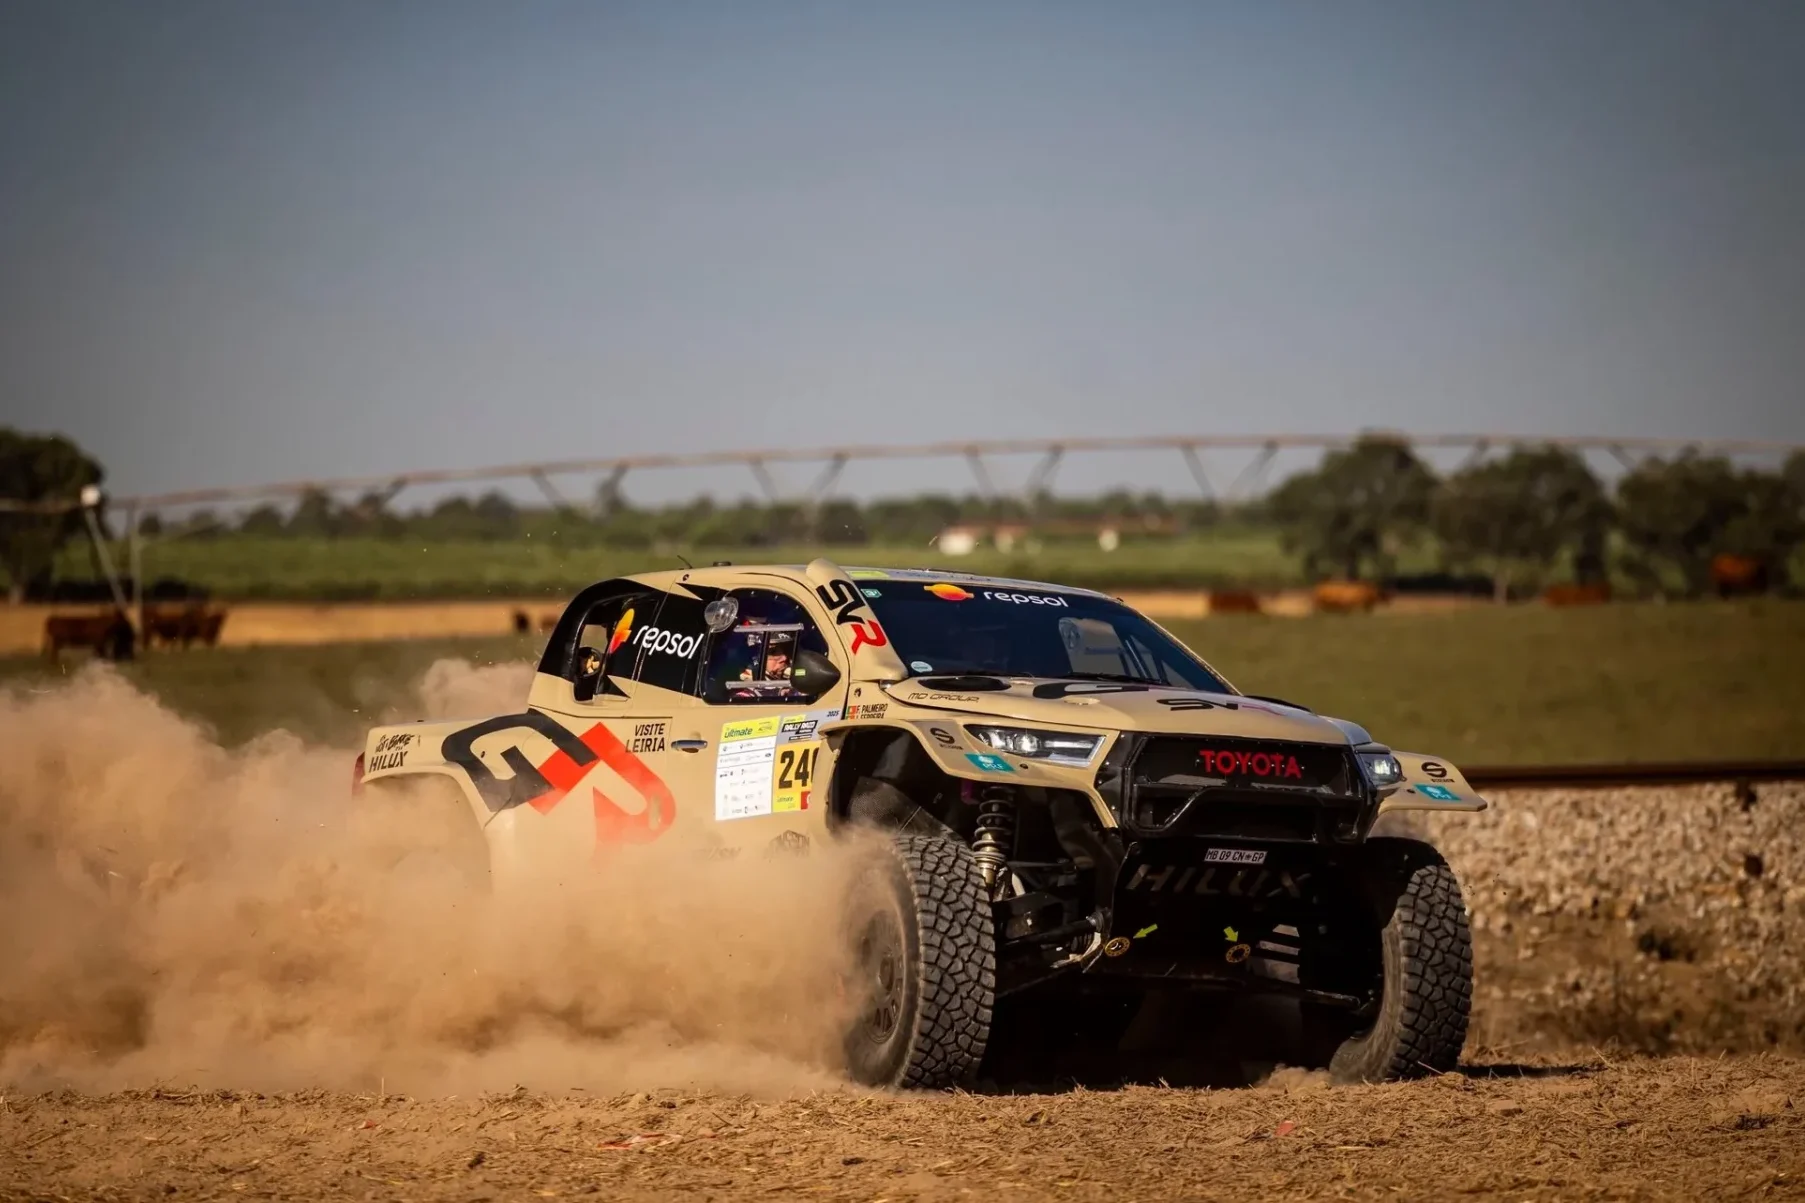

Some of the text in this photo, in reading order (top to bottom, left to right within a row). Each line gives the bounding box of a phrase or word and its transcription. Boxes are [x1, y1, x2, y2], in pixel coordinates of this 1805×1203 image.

[983, 591, 1069, 608] repsol
[633, 625, 704, 660] repsol
[930, 693, 980, 703] GROUP
[826, 710, 840, 718] 2025
[862, 703, 889, 713] PALMEIRO
[635, 723, 666, 736] VISITE
[625, 737, 665, 752] LEIRIA
[369, 750, 408, 773] HILUX
[1199, 750, 1302, 778] TOYOTA
[1219, 851, 1232, 860] 09
[1232, 851, 1246, 861] CN
[1252, 852, 1265, 862] GP
[1126, 864, 1312, 898] HILUX
